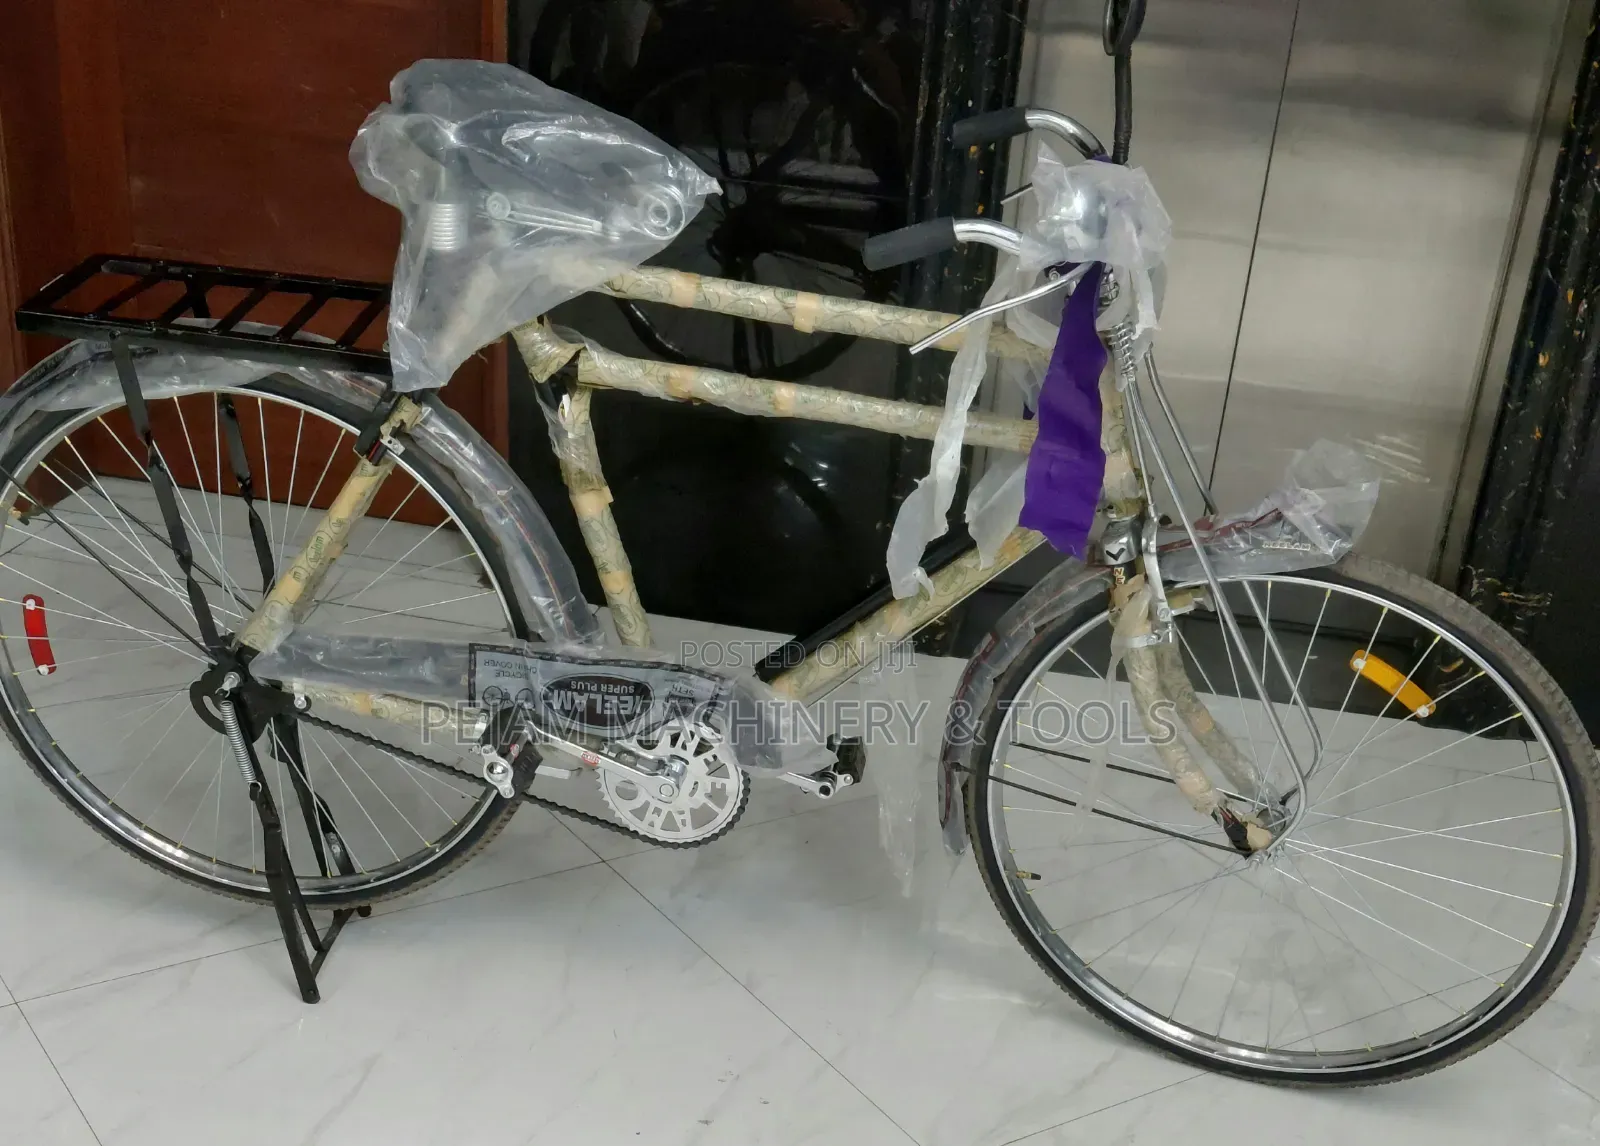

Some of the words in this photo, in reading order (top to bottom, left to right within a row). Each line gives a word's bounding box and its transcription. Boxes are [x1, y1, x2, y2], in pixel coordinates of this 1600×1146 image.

[484, 659, 513, 669] COVER
[570, 681, 598, 691] PLUS
[601, 683, 635, 693] SUPER
